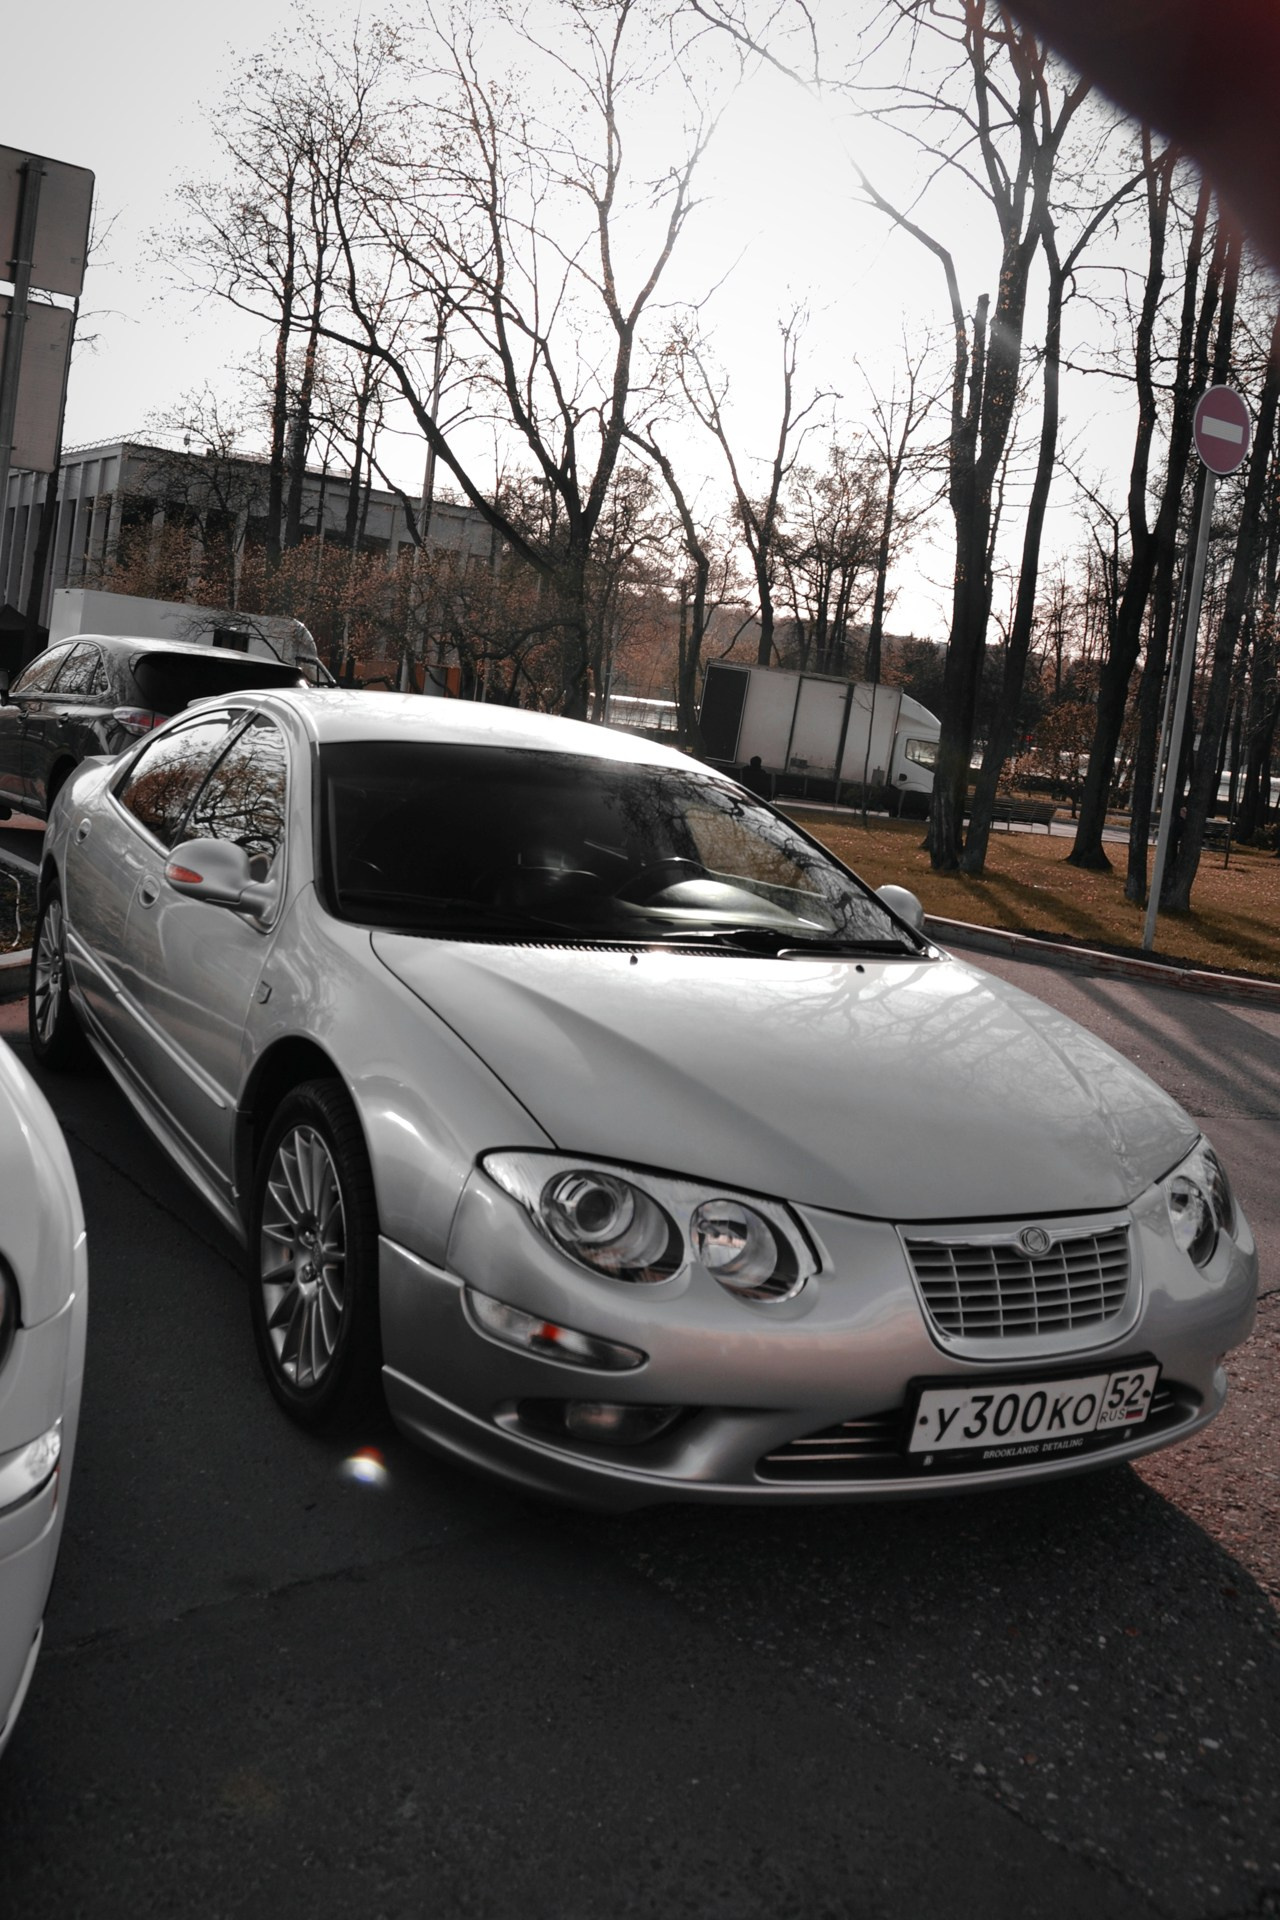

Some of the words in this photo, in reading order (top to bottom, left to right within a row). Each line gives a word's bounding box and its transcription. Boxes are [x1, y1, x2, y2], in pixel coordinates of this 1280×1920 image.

[1108, 1374, 1145, 1409] 52
[1100, 1408, 1125, 1423] RUS
[982, 1445, 1039, 1459] BROOKLANDS
[1042, 1438, 1084, 1452] DETAILING
